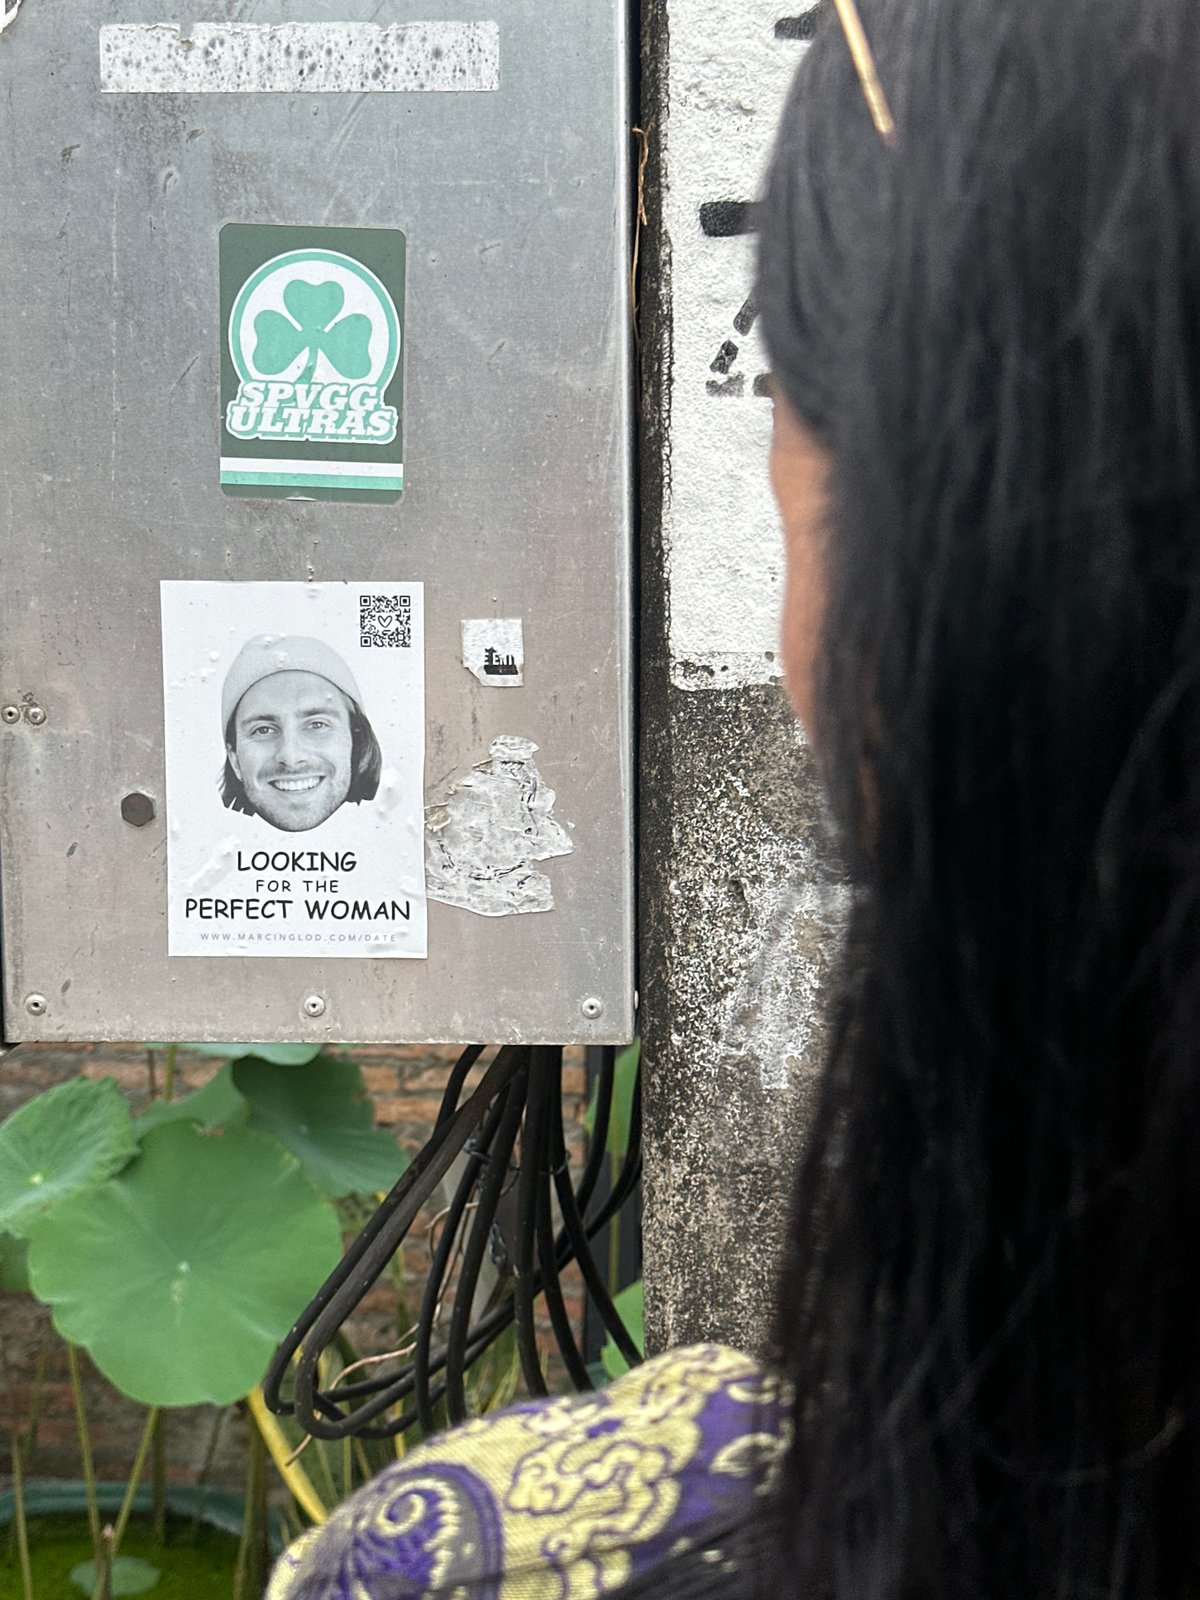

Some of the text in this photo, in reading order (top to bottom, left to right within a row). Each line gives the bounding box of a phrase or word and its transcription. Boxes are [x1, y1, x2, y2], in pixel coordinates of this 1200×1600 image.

[241, 381, 380, 411] SPVGG
[231, 405, 393, 437] ULTRAS
[237, 850, 357, 872] LOOKING
[256, 880, 339, 893] FOR THE
[185, 898, 410, 920] PERFECT WOMAN
[200, 932, 397, 942] WWW.MARCINGLOD.COM/DATE
